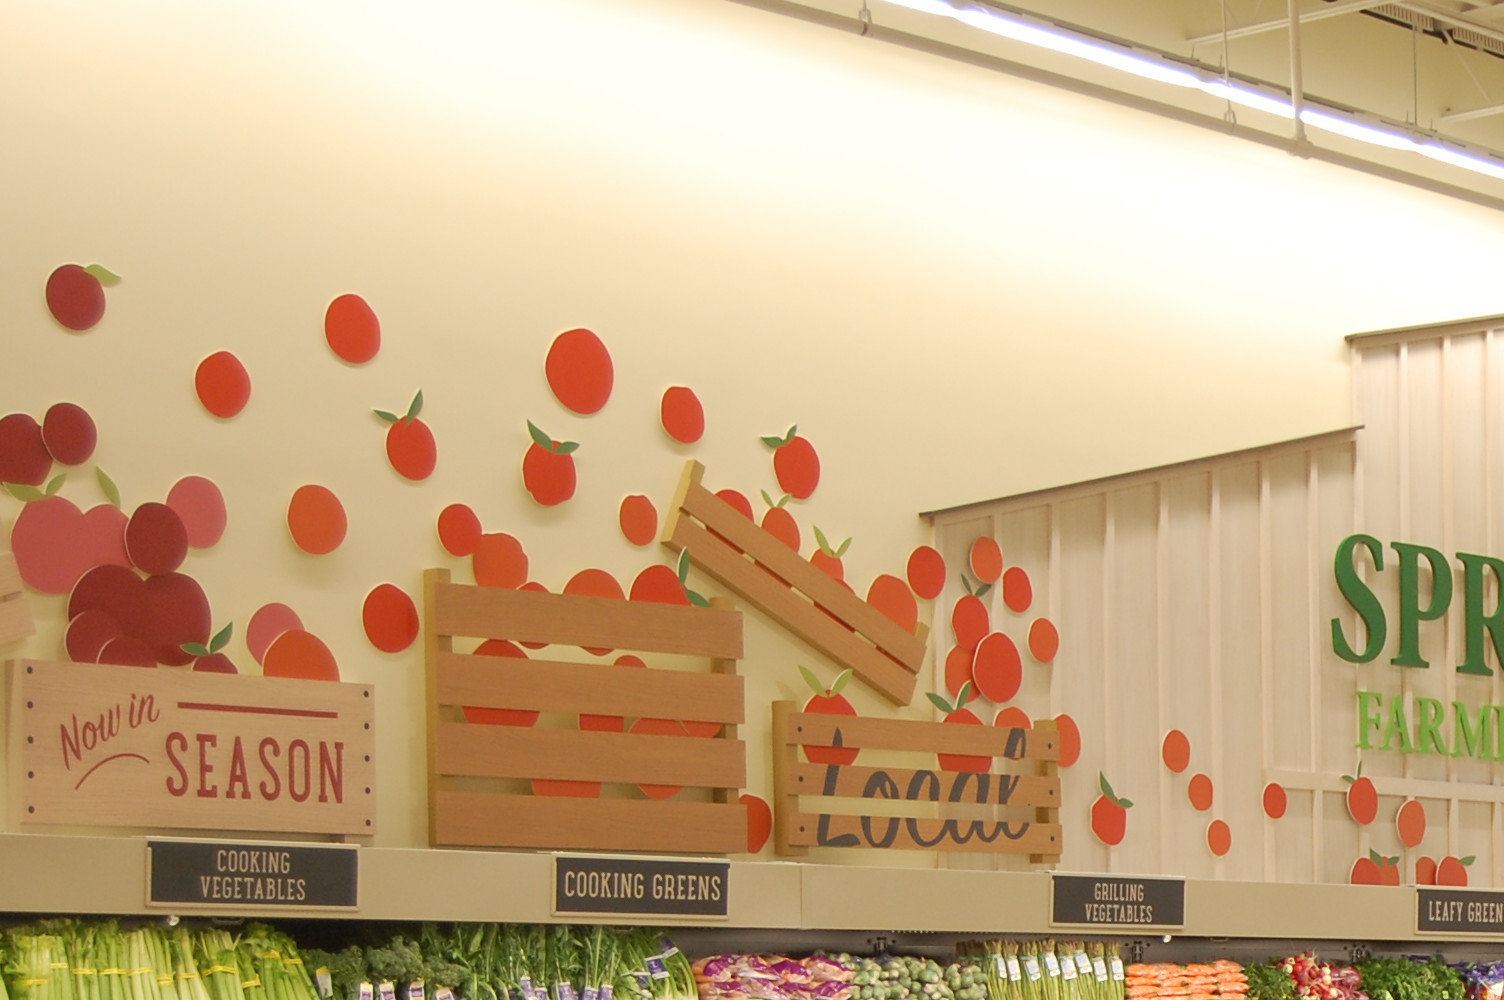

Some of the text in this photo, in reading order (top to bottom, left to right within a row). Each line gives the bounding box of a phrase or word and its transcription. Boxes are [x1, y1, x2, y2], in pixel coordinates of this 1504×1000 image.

[60, 693, 160, 771] Now in
[166, 732, 344, 804] SEASON
[817, 727, 1029, 848] Local
[217, 850, 291, 874] COOKING
[200, 876, 306, 901] VEGETABLES
[564, 871, 722, 901] COOKING GREENS
[1094, 883, 1144, 902] GRILLING
[1085, 904, 1153, 923] VEGETABLES
[1428, 901, 1464, 922] LEAFY
